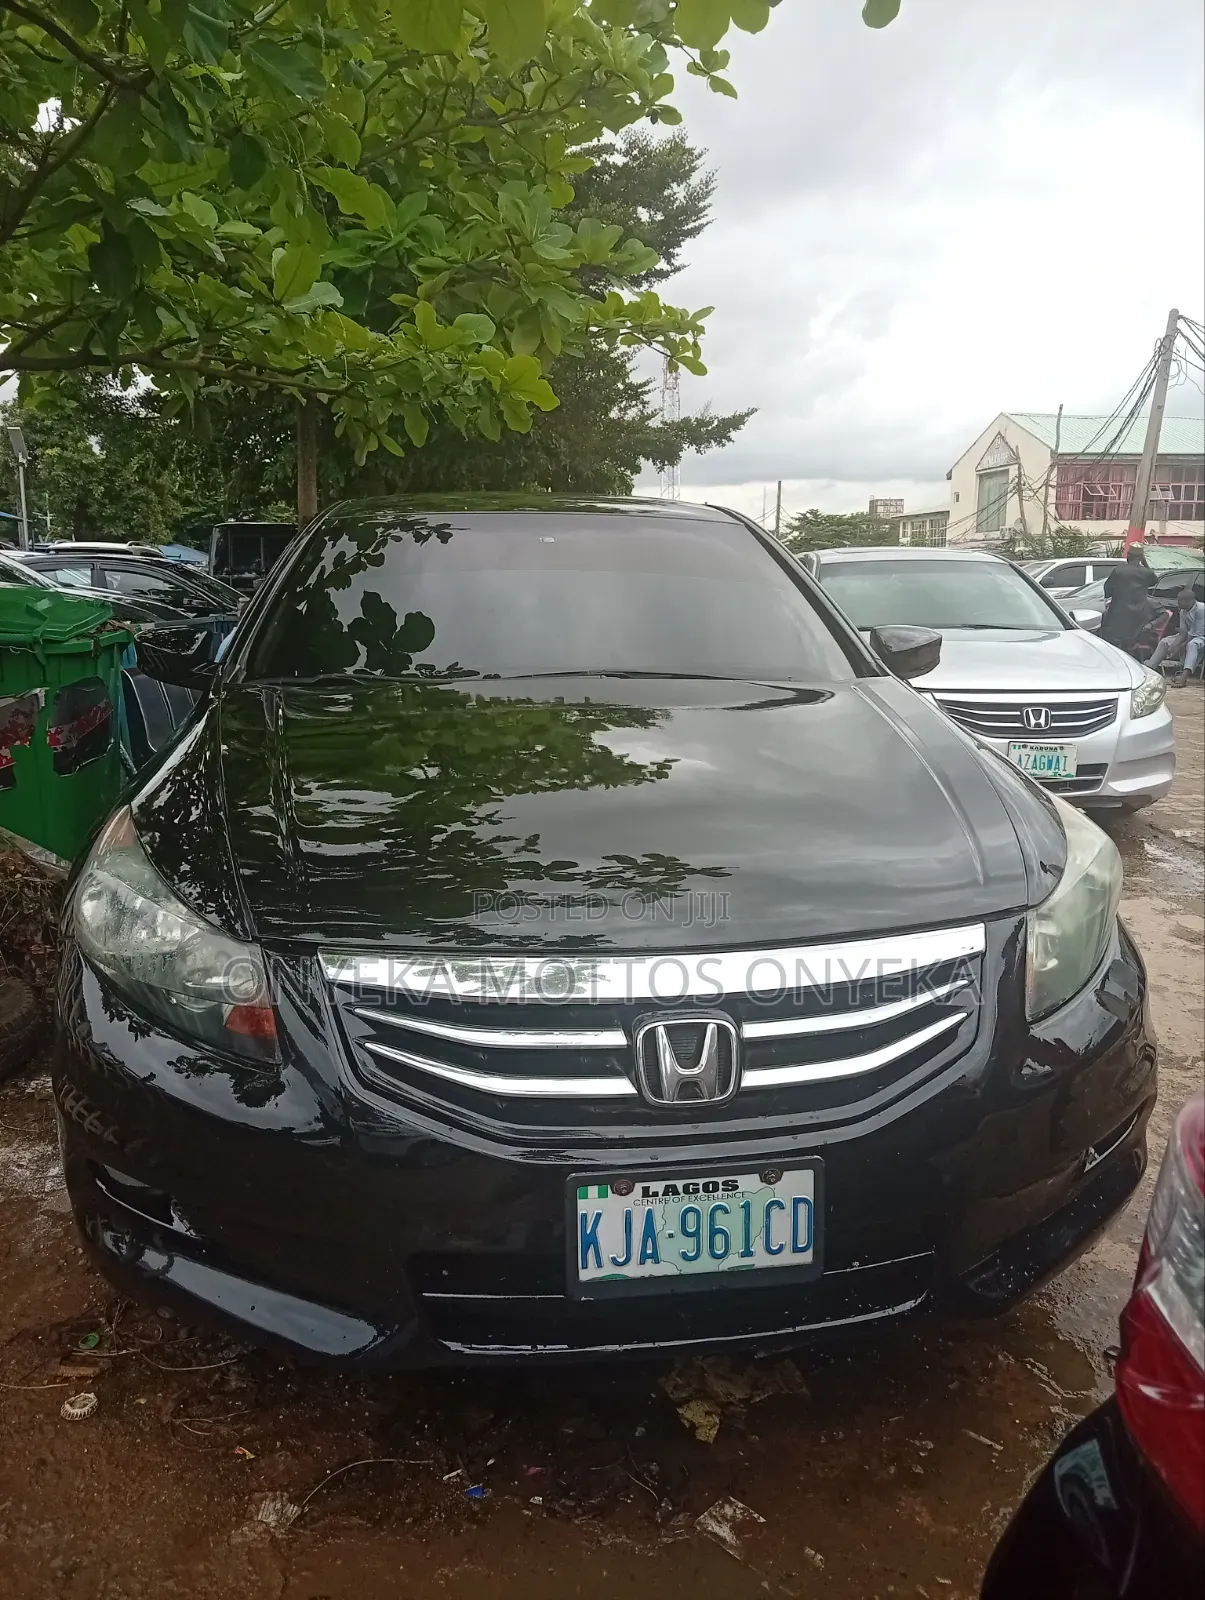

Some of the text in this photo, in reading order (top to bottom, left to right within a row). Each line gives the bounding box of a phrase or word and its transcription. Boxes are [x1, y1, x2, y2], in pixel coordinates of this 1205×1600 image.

[1017, 753, 1068, 772] AZAGWAI
[641, 1179, 740, 1199] LAGOS
[633, 1191, 748, 1207] CENTRE OF EXCELLENCE
